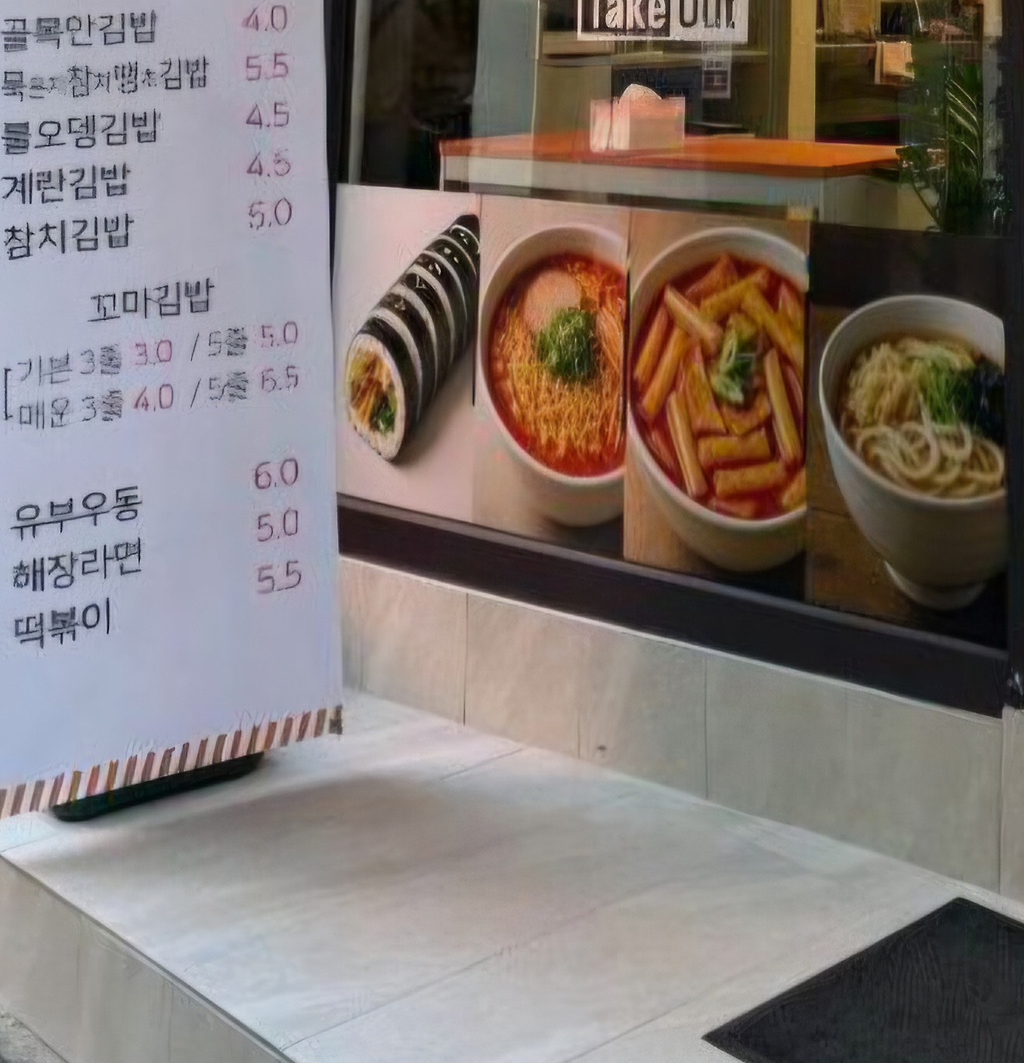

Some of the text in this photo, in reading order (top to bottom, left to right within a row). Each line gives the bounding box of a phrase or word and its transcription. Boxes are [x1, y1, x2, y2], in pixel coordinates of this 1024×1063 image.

[242, 4, 288, 33] 4.0
[245, 52, 290, 82] 5.5
[245, 101, 291, 129] 4.5
[2, 162, 132, 205] 계란김밥
[4, 196, 293, 261] 참치김밥 5.0
[88, 277, 215, 322] 꼬마김밥
[17, 352, 72, 386] 기본
[134, 339, 173, 366] 3.0
[133, 383, 174, 412] 4.0
[254, 458, 299, 490] 6.0
[10, 486, 143, 541] 유부우동
[256, 508, 299, 543] 5.0
[13, 537, 142, 592] 해장라면
[256, 560, 302, 595] 5.5
[14, 597, 111, 649] 떡볶이
